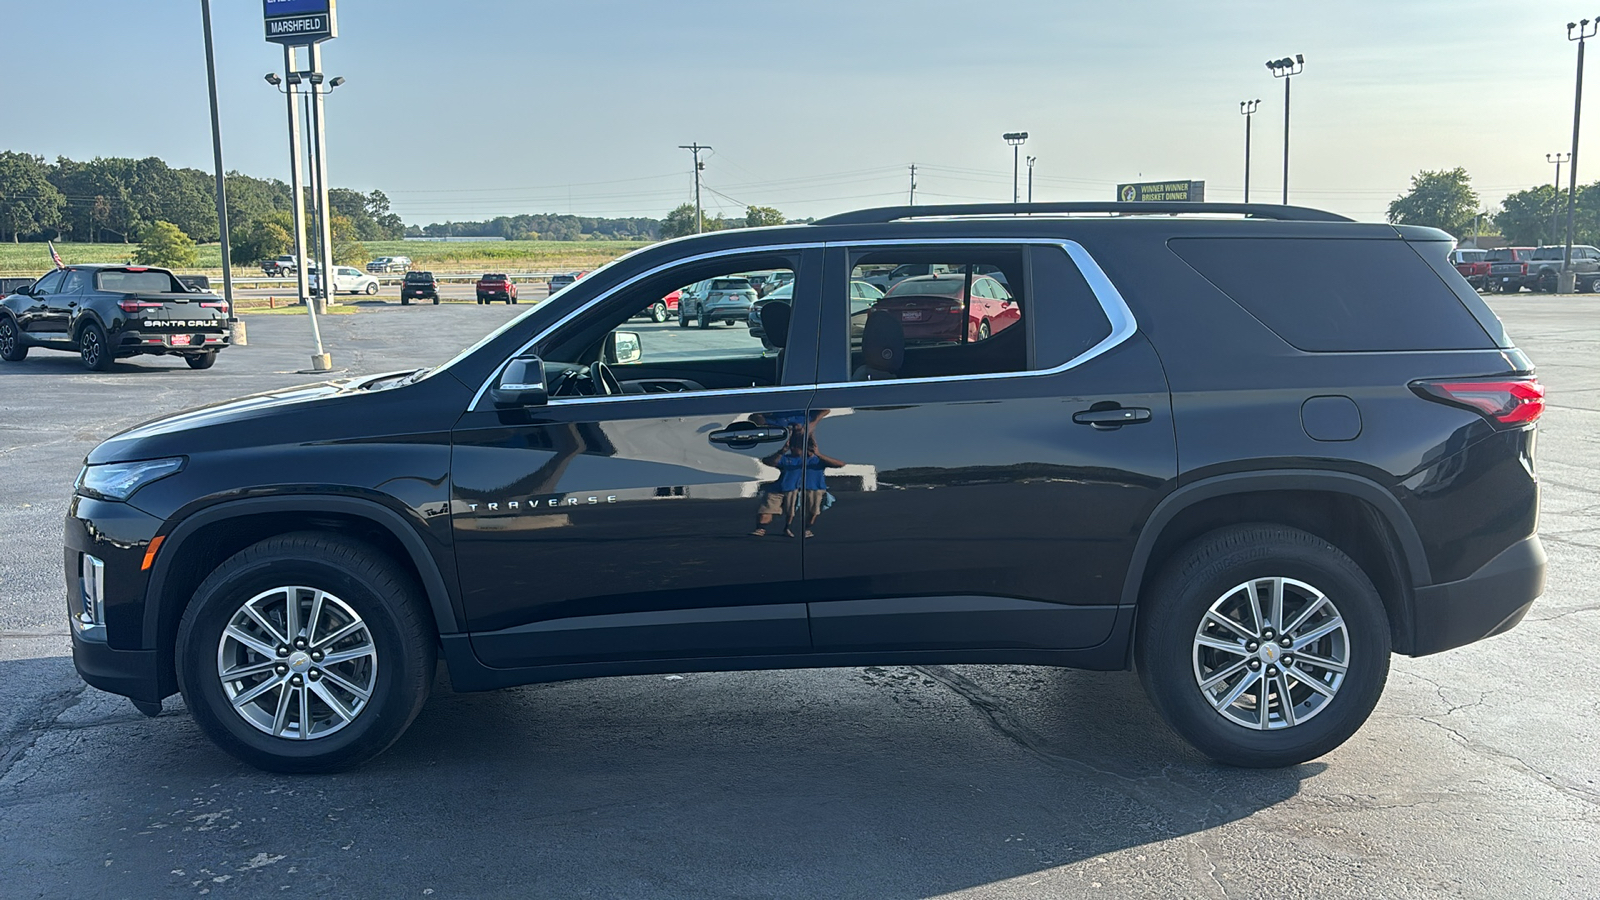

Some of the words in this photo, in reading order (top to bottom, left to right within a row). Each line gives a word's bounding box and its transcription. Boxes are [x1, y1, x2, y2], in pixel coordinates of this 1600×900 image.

[271, 18, 320, 33] MARSHFIELD
[1141, 185, 1164, 193] WINNER
[1165, 184, 1188, 192] WINNER
[1142, 193, 1165, 201] BRISKET
[1166, 192, 1187, 200] DINNER
[468, 495, 617, 512] TRAVERSE
